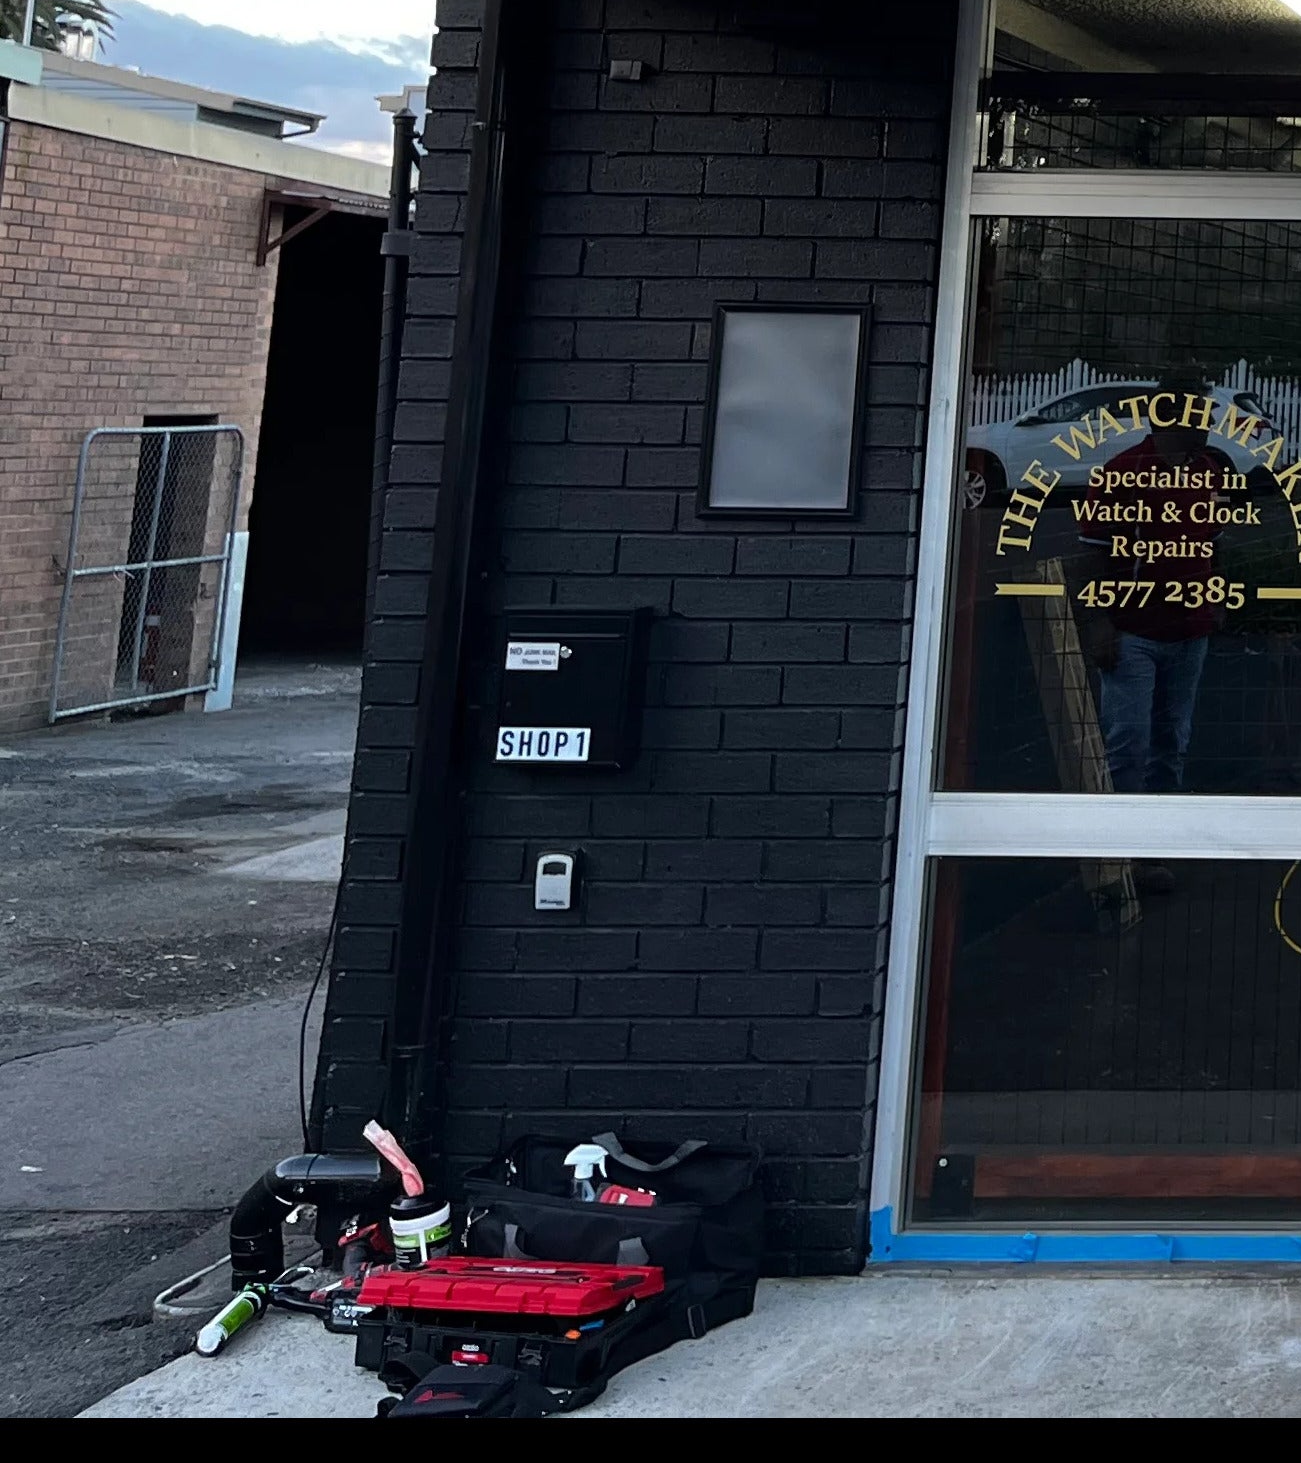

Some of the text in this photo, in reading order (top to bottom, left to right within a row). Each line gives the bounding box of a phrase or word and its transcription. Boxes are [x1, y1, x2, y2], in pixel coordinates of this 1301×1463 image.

[1087, 465, 1248, 494] Specialist in
[995, 459, 1062, 557] THE
[1071, 499, 1262, 525] Watch & Clock
[1110, 535, 1214, 564] Repairs
[1077, 575, 1246, 610] 4577 2385
